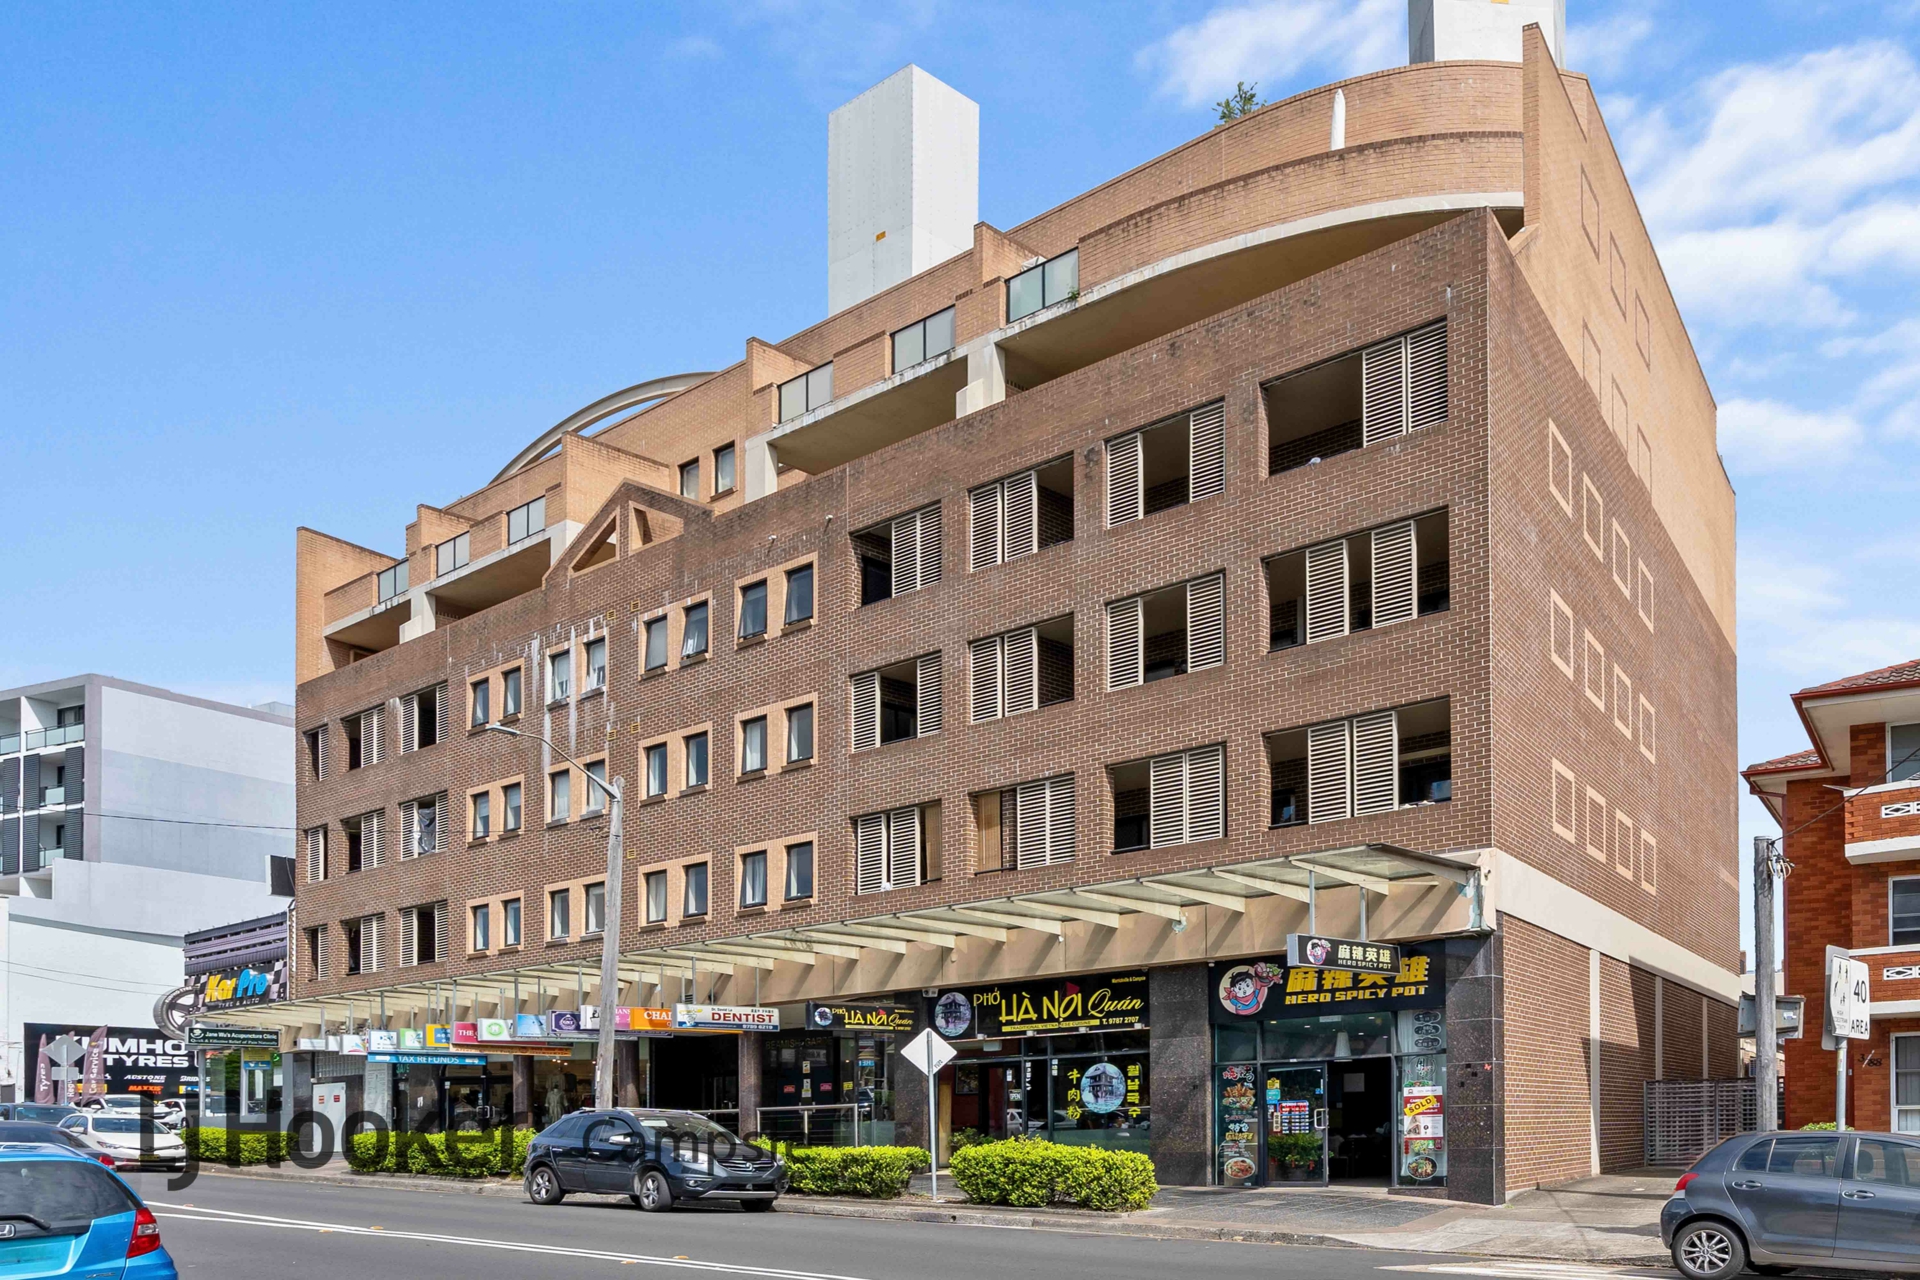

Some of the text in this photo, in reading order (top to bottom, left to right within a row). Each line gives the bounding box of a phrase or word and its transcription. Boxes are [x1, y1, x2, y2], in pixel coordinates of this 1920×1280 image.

[1338, 944, 1391, 963] 麻辣英雄
[1285, 984, 1428, 1004] HERO SPICY POT
[1854, 980, 1867, 1004] 40
[998, 992, 1038, 1023] HÀ
[1088, 988, 1144, 1017] Quán
[711, 1012, 774, 1023] DENTIST
[888, 1014, 914, 1026] Quán
[1851, 1020, 1868, 1034] AREA
[55, 1036, 188, 1055] UMHO
[102, 1054, 189, 1068] TYRES
[416, 1056, 460, 1064] REFUNDS
[40, 1063, 50, 1092] Tyres
[1067, 1068, 1082, 1120] 牛肉粉
[1127, 1065, 1140, 1118] 월남국수
[1408, 1097, 1432, 1114] SOLD
